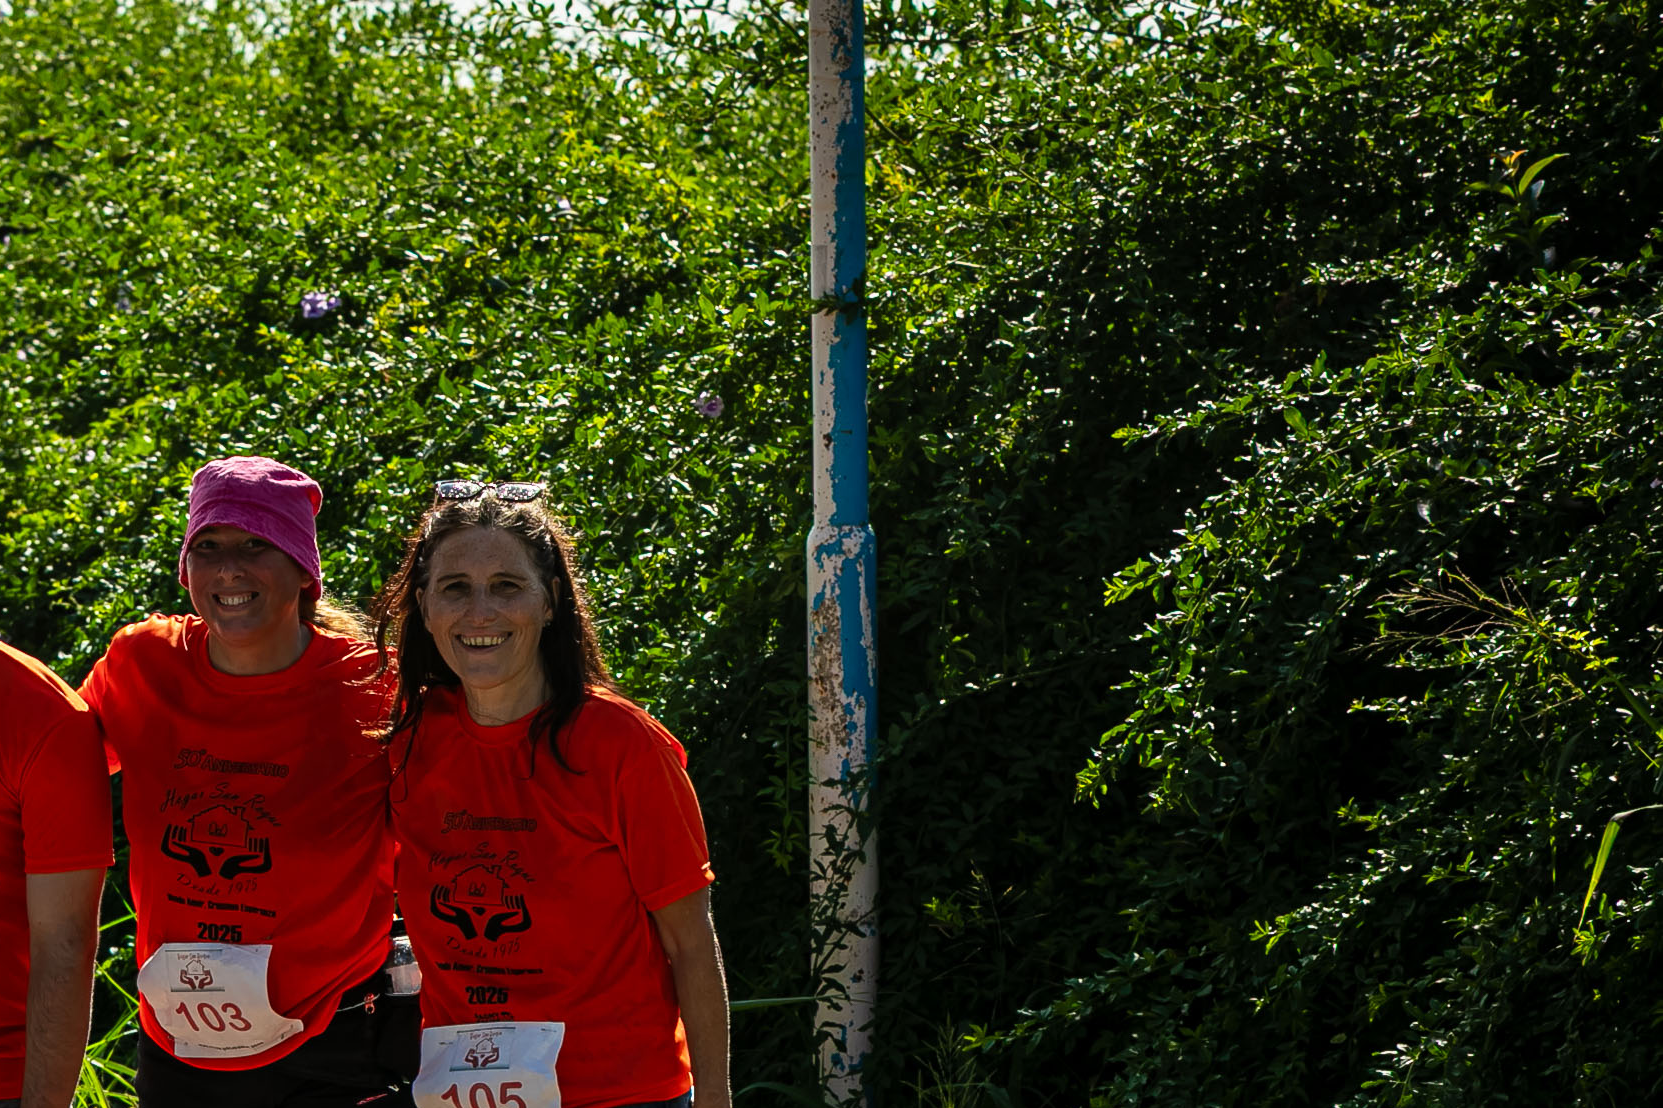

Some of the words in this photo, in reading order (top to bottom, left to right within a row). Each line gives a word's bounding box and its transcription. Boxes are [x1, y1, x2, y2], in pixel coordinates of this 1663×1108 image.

[197, 922, 242, 943] 2025
[465, 985, 510, 1005] 2025
[175, 1001, 252, 1032] 103
